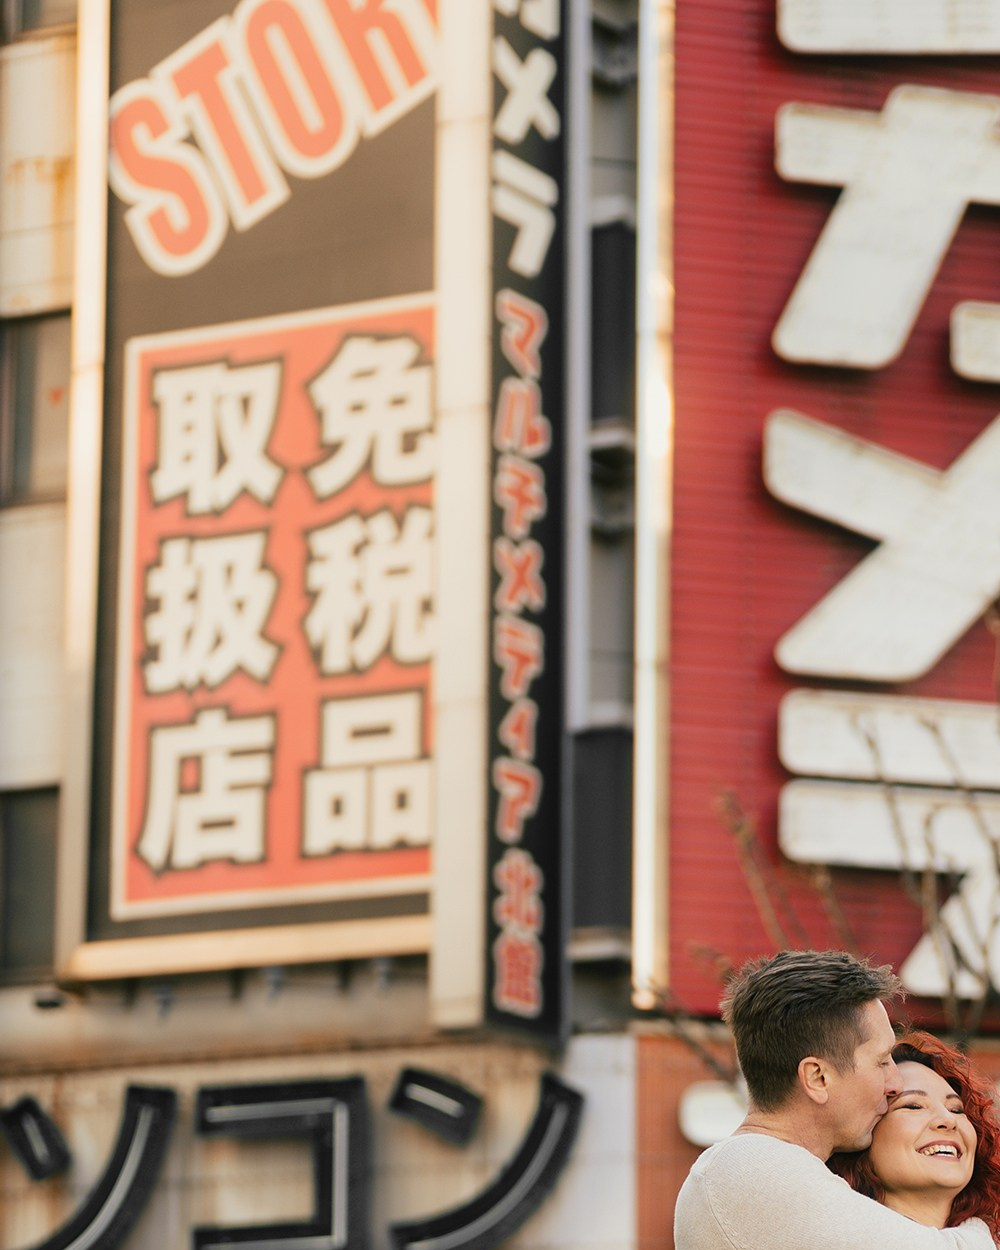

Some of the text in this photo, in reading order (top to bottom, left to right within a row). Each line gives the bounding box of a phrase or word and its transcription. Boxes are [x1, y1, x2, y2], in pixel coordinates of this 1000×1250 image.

[108, 0, 438, 277] STOR
[493, 0, 562, 279] メラ
[135, 357, 287, 876] 取扱店
[302, 334, 437, 857] 免税品
